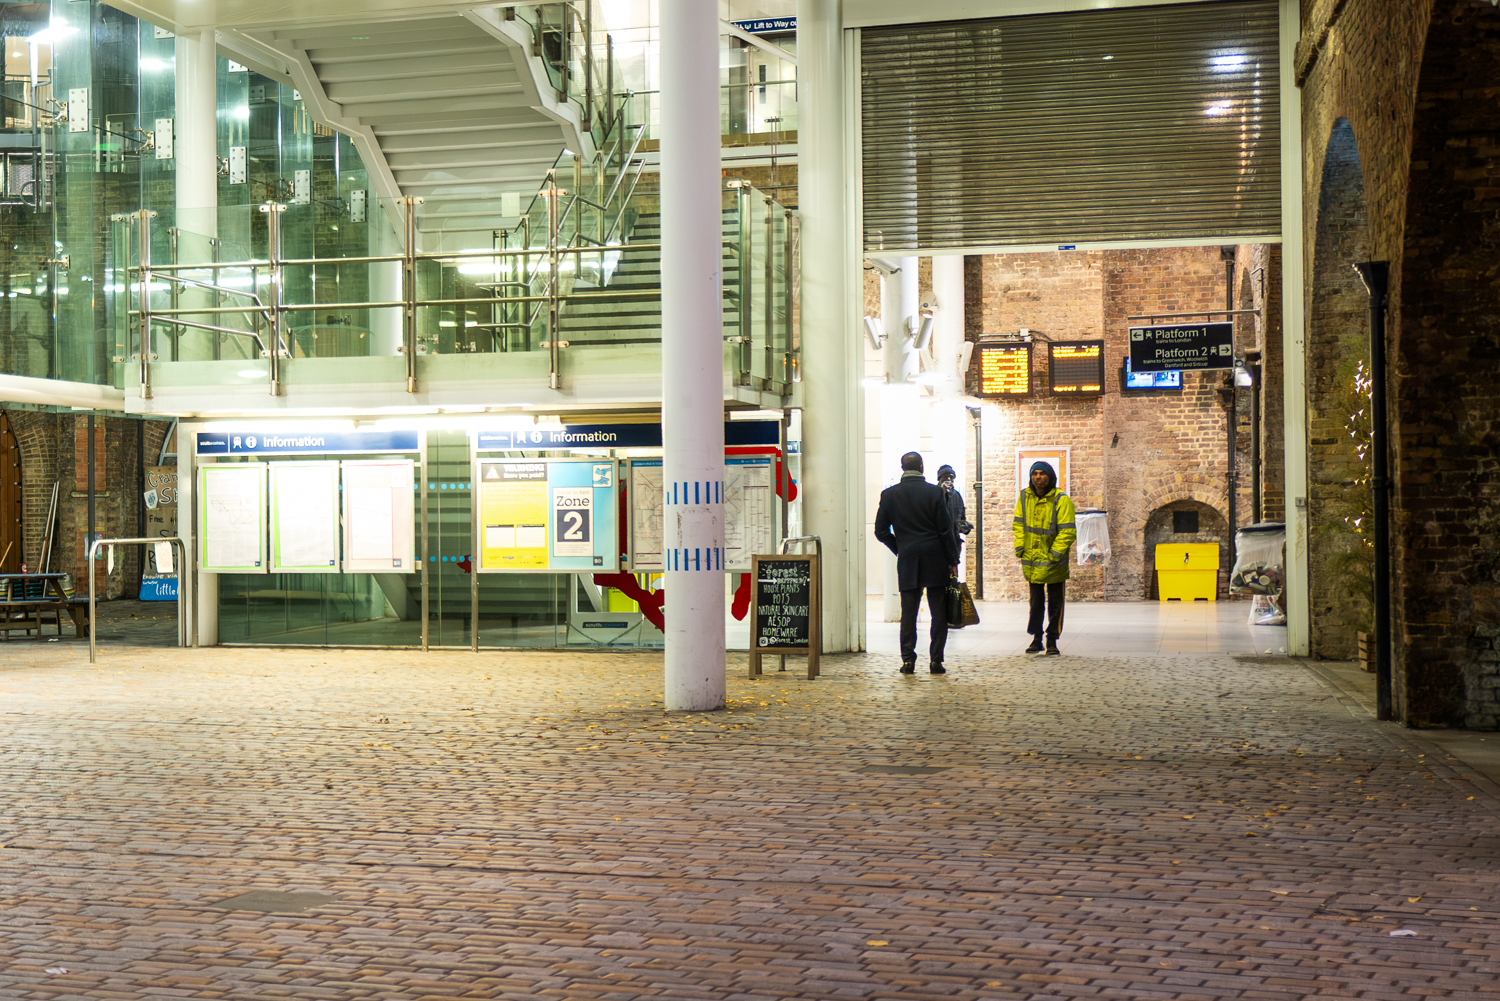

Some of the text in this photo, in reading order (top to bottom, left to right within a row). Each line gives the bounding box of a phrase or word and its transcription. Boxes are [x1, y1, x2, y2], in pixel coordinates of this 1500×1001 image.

[773, 20, 789, 28] Way
[1155, 327, 1207, 339] Platform 1
[1155, 346, 1208, 358] Platform 2
[263, 435, 325, 448] Information
[549, 430, 617, 444] Information
[556, 495, 590, 507] Zone
[563, 510, 583, 540] 2
[766, 564, 798, 579] forest
[155, 583, 179, 596] little
[763, 584, 800, 594] HOUSE PLANTS
[772, 593, 790, 604] POTS
[758, 605, 809, 617] NATURAL SKINCARE
[767, 616, 791, 627] AESOP
